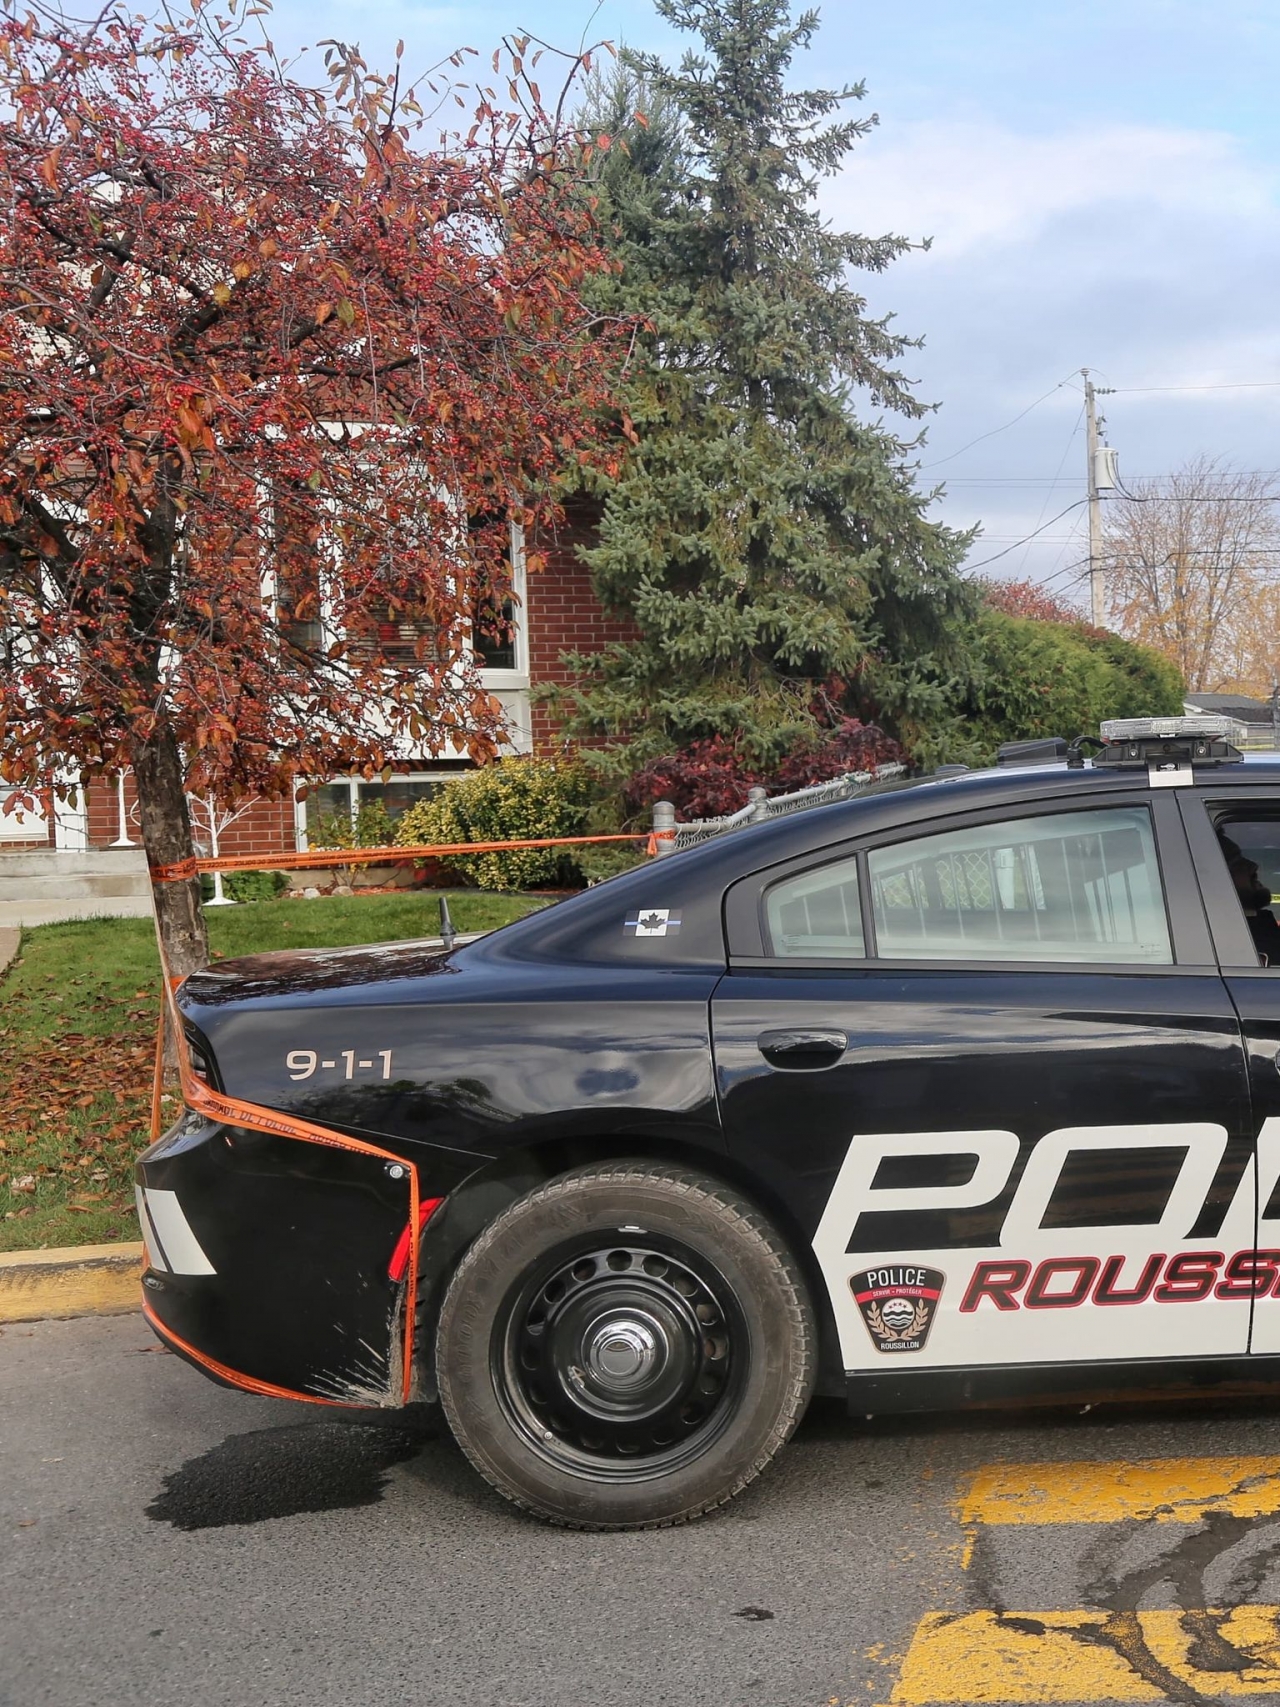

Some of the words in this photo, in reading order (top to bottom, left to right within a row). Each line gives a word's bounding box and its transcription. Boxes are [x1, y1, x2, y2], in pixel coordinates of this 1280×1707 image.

[286, 1049, 392, 1081] 9-1-1
[866, 1268, 927, 1289] POLICE
[880, 1341, 920, 1350] ROUSSILLON
